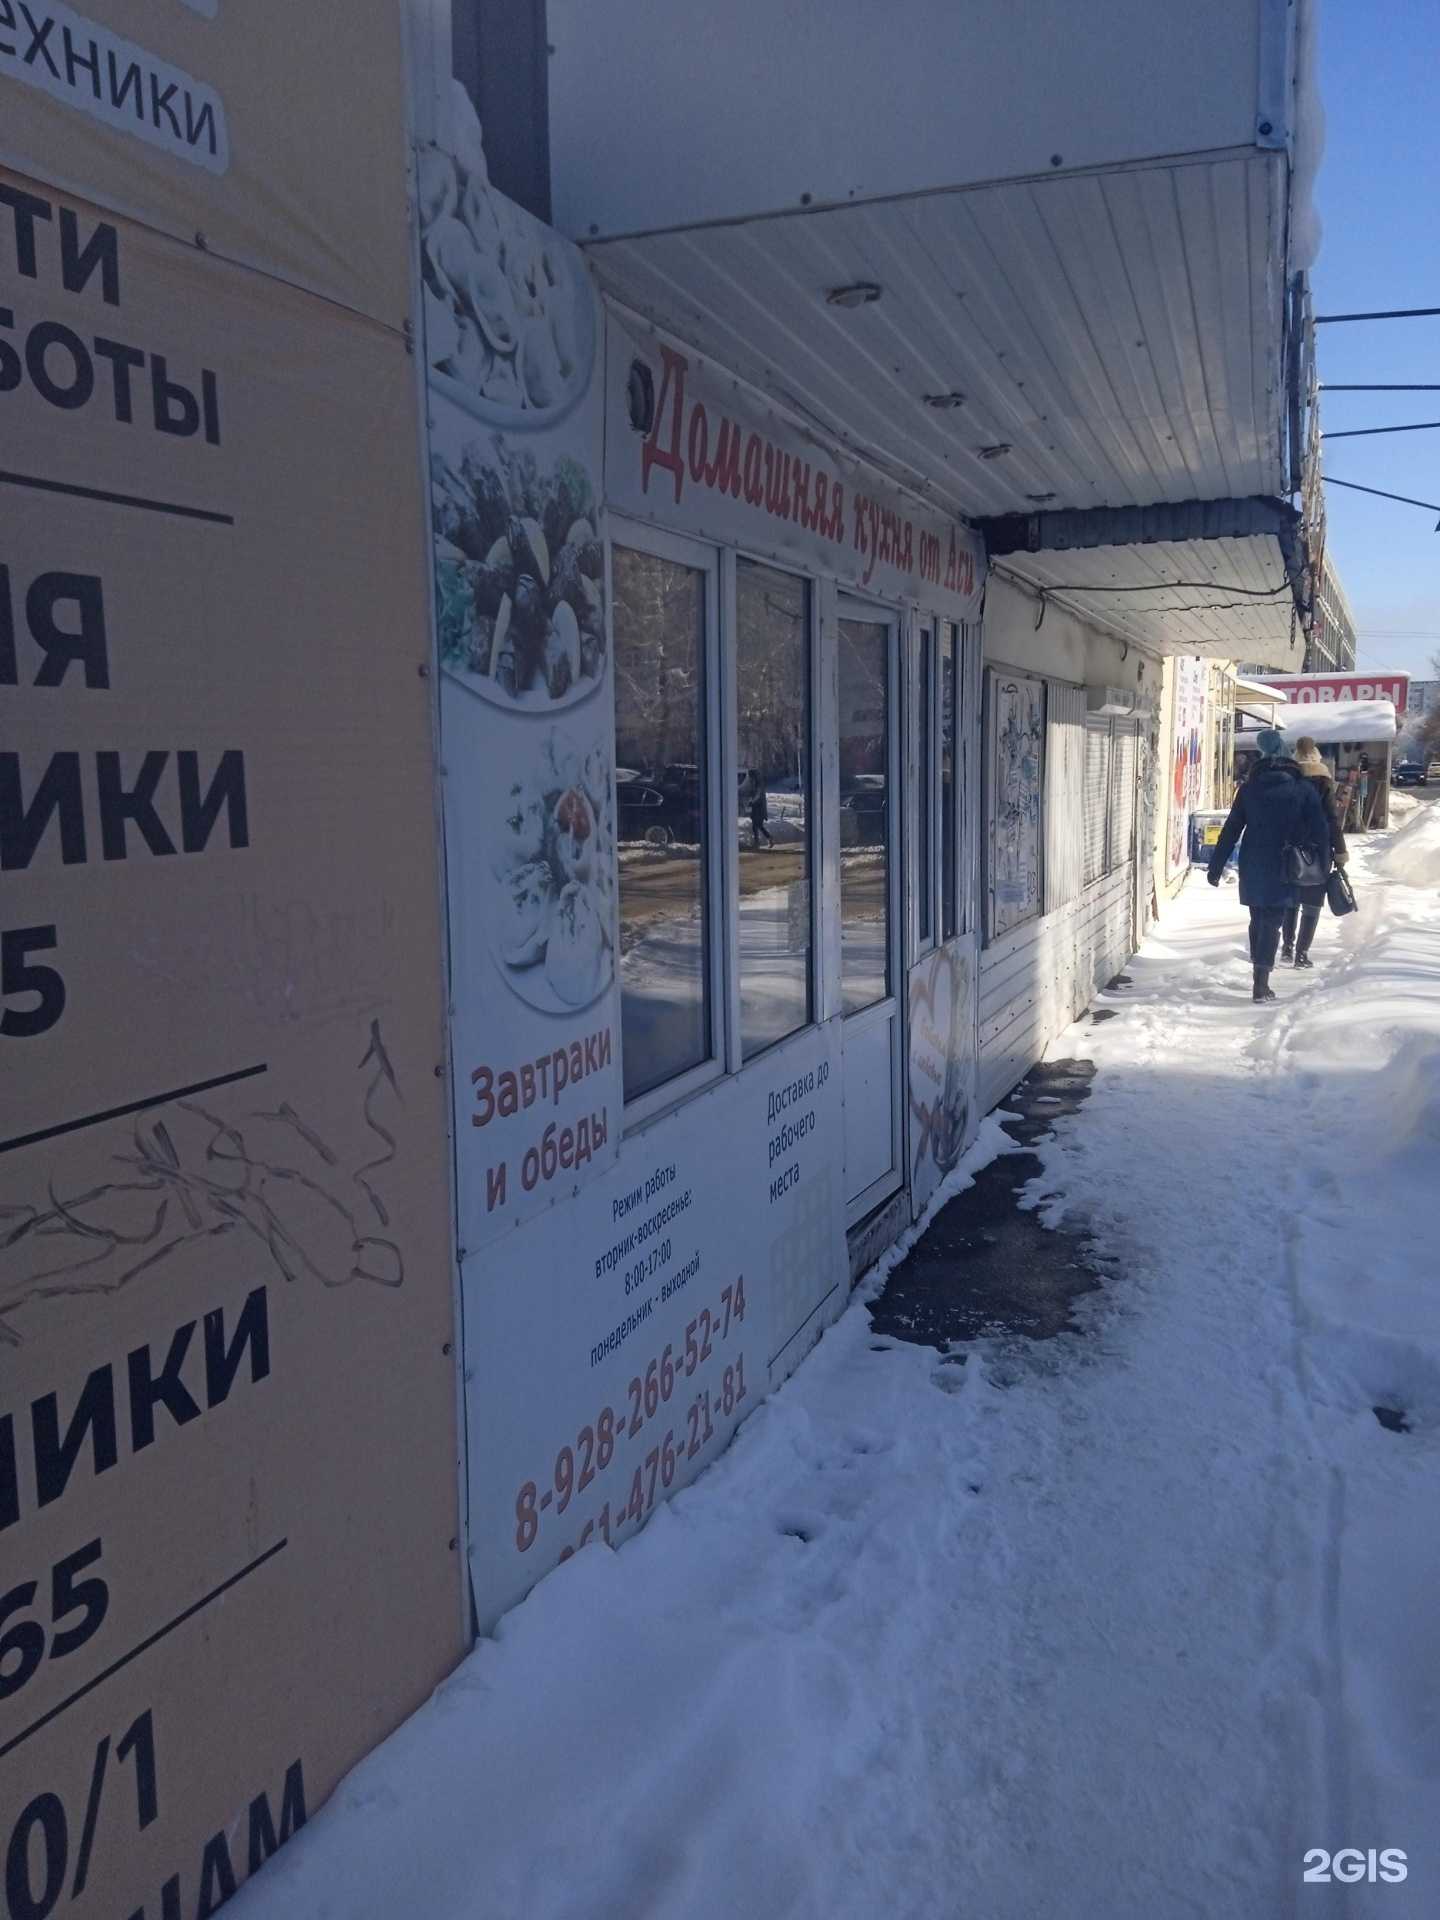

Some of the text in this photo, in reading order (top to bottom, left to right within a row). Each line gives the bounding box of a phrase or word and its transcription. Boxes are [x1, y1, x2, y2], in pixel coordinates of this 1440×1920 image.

[641, 343, 845, 544] Домашняя
[853, 493, 914, 585] кухня
[919, 529, 941, 585] от
[1281, 683, 1401, 706] ТОВАРЫ
[0, 924, 67, 1038] 5
[471, 1026, 612, 1128] Завтраки
[767, 1060, 830, 1125] Доставка до
[486, 1106, 608, 1212] и обеды
[768, 1110, 816, 1168] рабочего
[769, 1162, 800, 1204] места
[595, 1189, 693, 1279] вторник-воскресенье:
[612, 1163, 676, 1223] Режим работы
[590, 1297, 653, 1368] понедельник
[661, 1251, 701, 1303] выходной
[624, 1239, 673, 1296] 8:00-17:00
[515, 1274, 747, 1552] 8-928-266-52-74
[559, 1352, 747, 1561] 1-476-21-81
[0, 1537, 110, 1702] 65
[5, 1708, 158, 1920] 0/1
